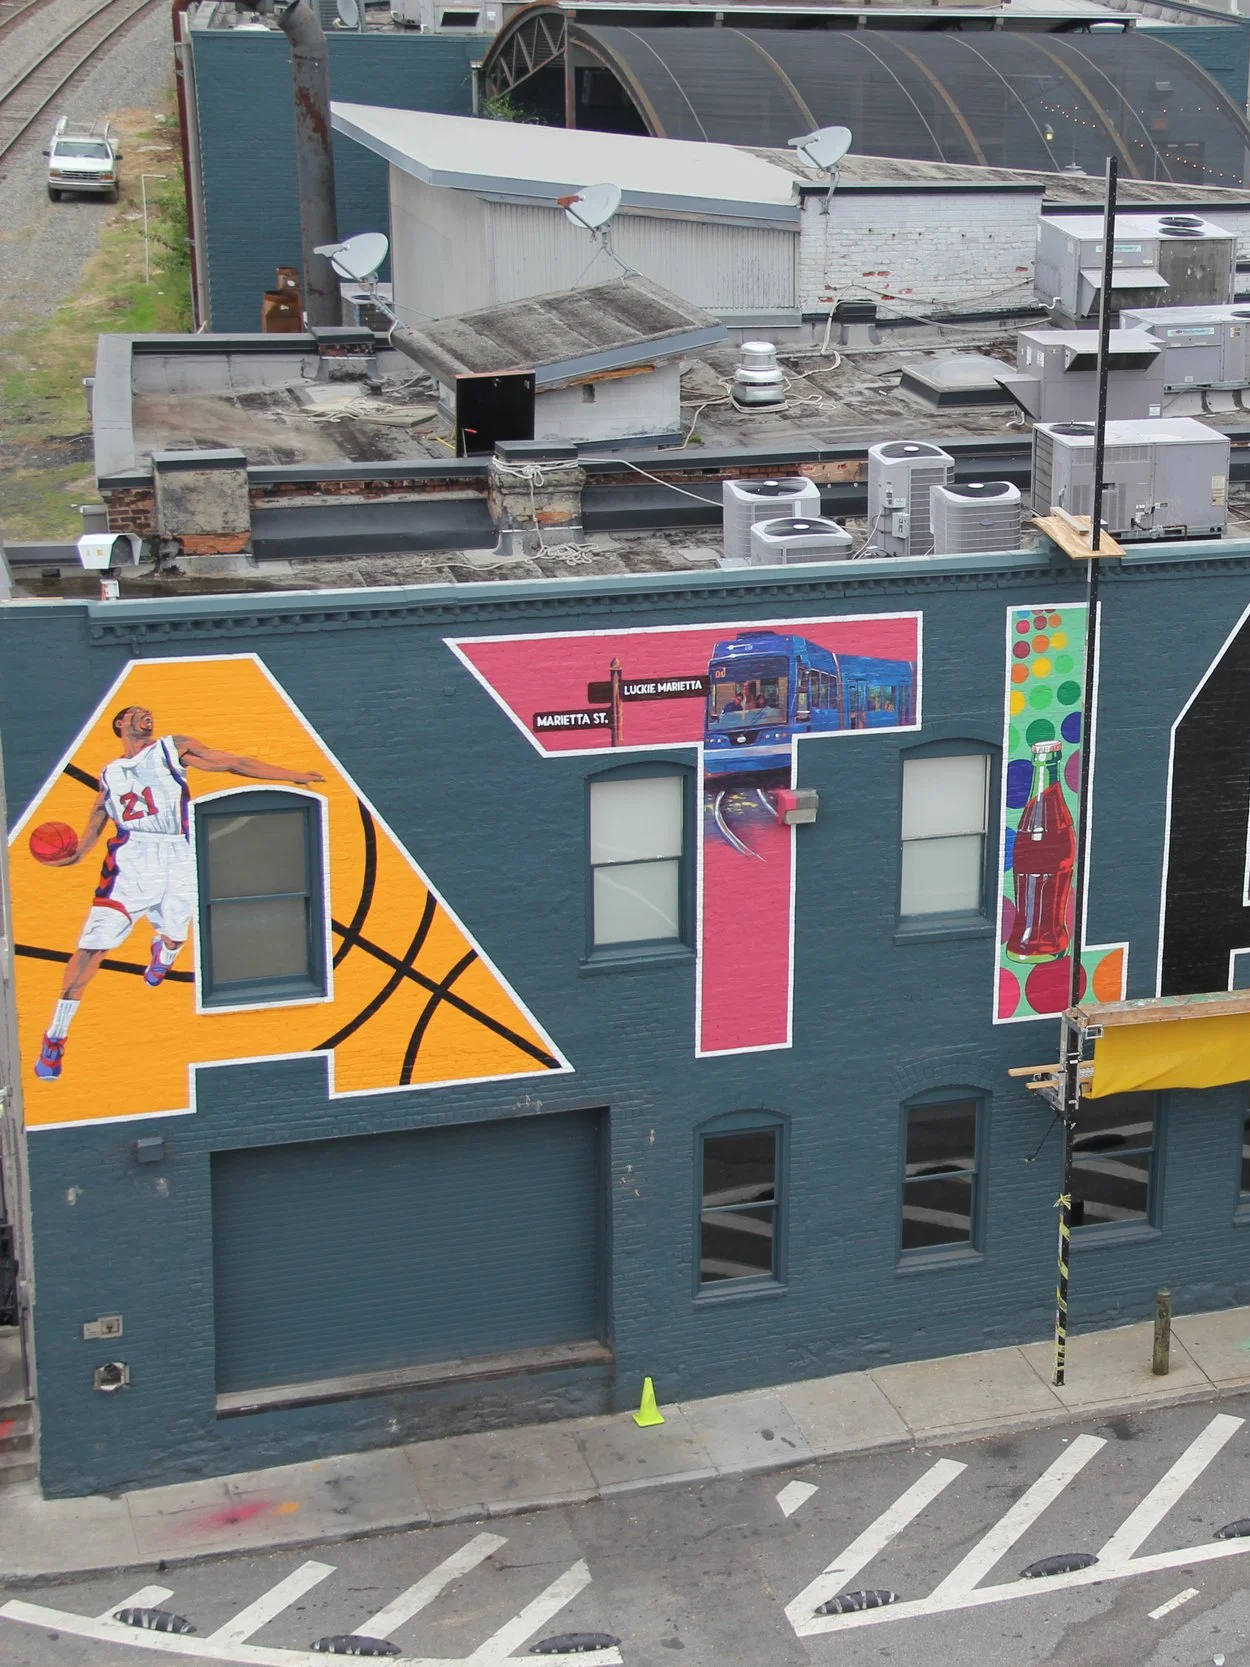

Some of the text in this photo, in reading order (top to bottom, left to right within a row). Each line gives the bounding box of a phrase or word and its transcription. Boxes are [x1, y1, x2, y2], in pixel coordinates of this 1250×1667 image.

[624, 680, 702, 695] LUCKIE MARIETTA
[537, 712, 609, 727] MARIETTA ST.
[119, 786, 159, 822] 21
